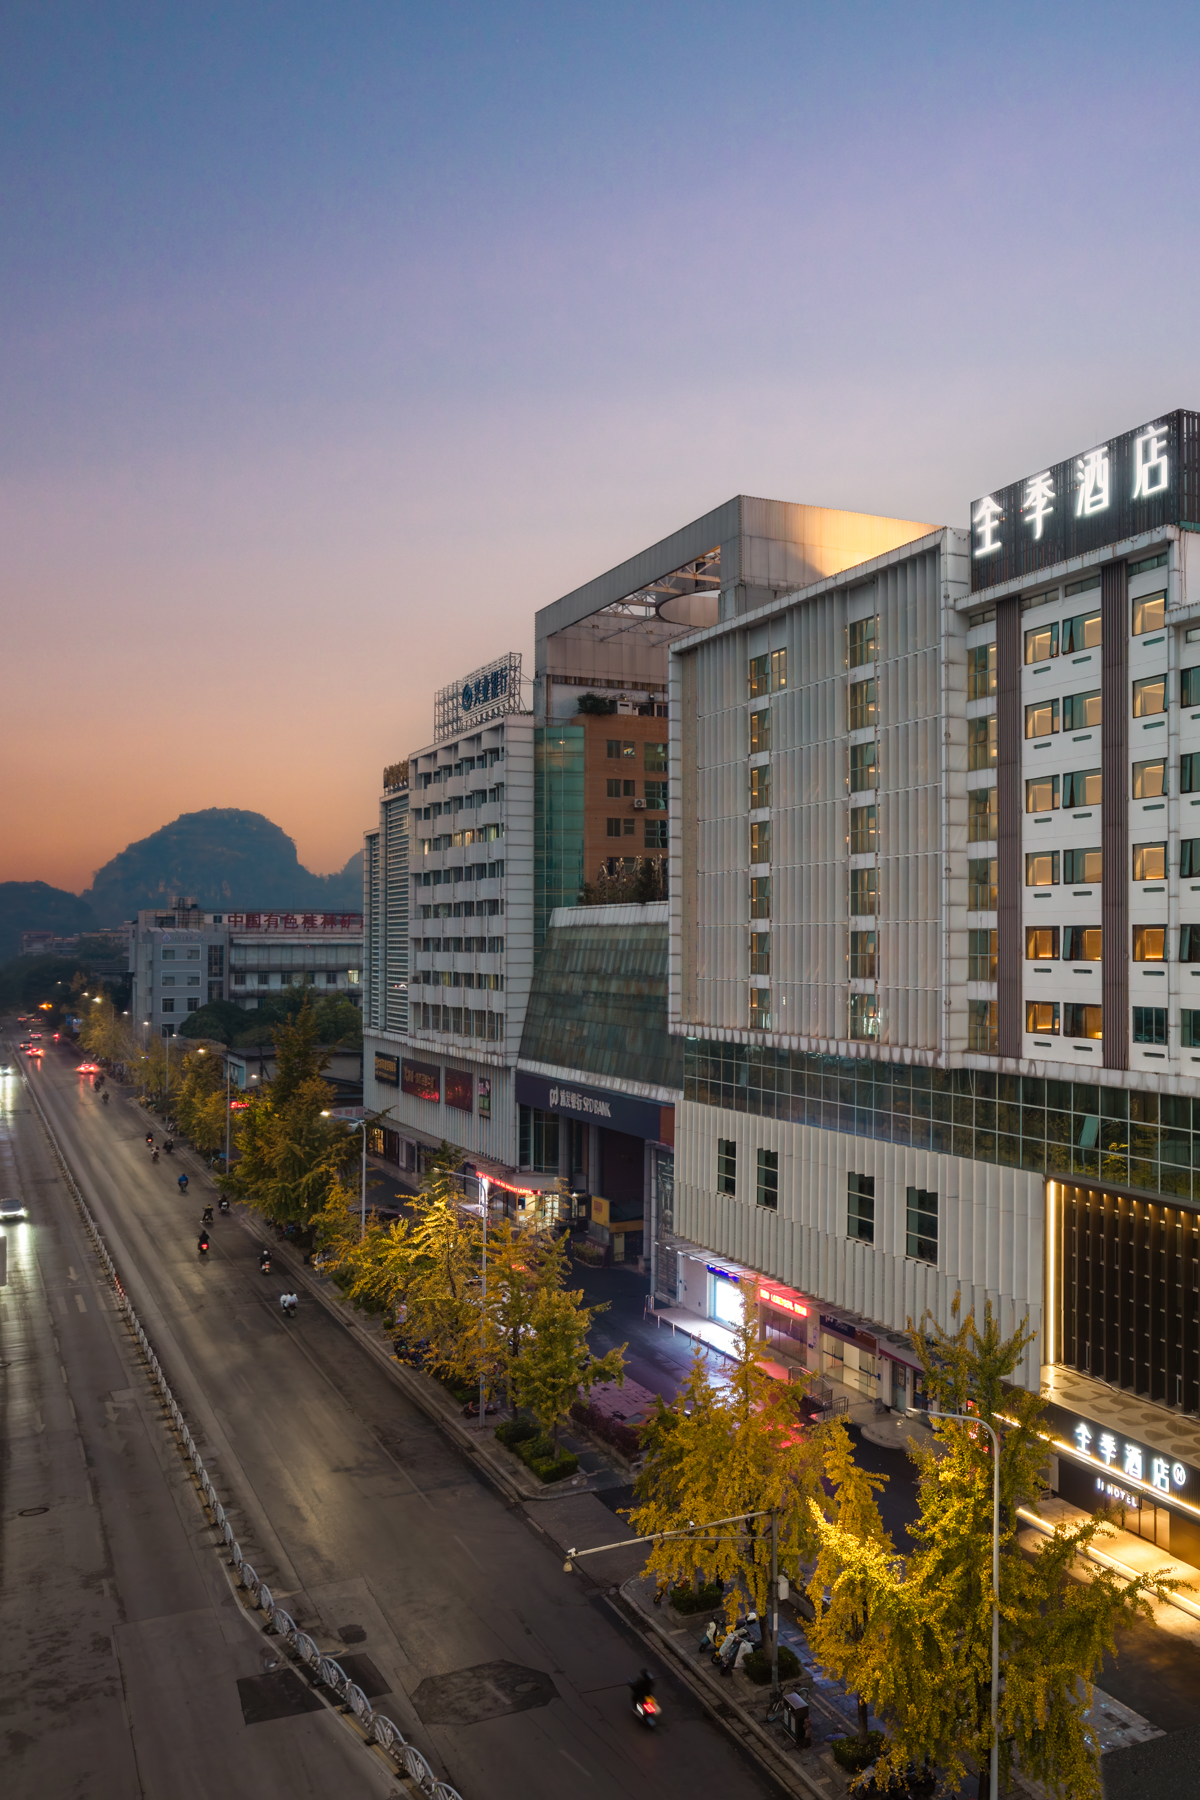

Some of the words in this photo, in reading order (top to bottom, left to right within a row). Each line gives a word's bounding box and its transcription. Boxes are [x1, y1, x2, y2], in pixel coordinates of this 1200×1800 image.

[973, 425, 1169, 556] 全季酒店
[473, 665, 508, 707] 兴业银行
[227, 912, 364, 929] 中国有色桂林矿
[1074, 1422, 1170, 1493] 全季酒店
[1107, 1484, 1138, 1508] HOTEL
